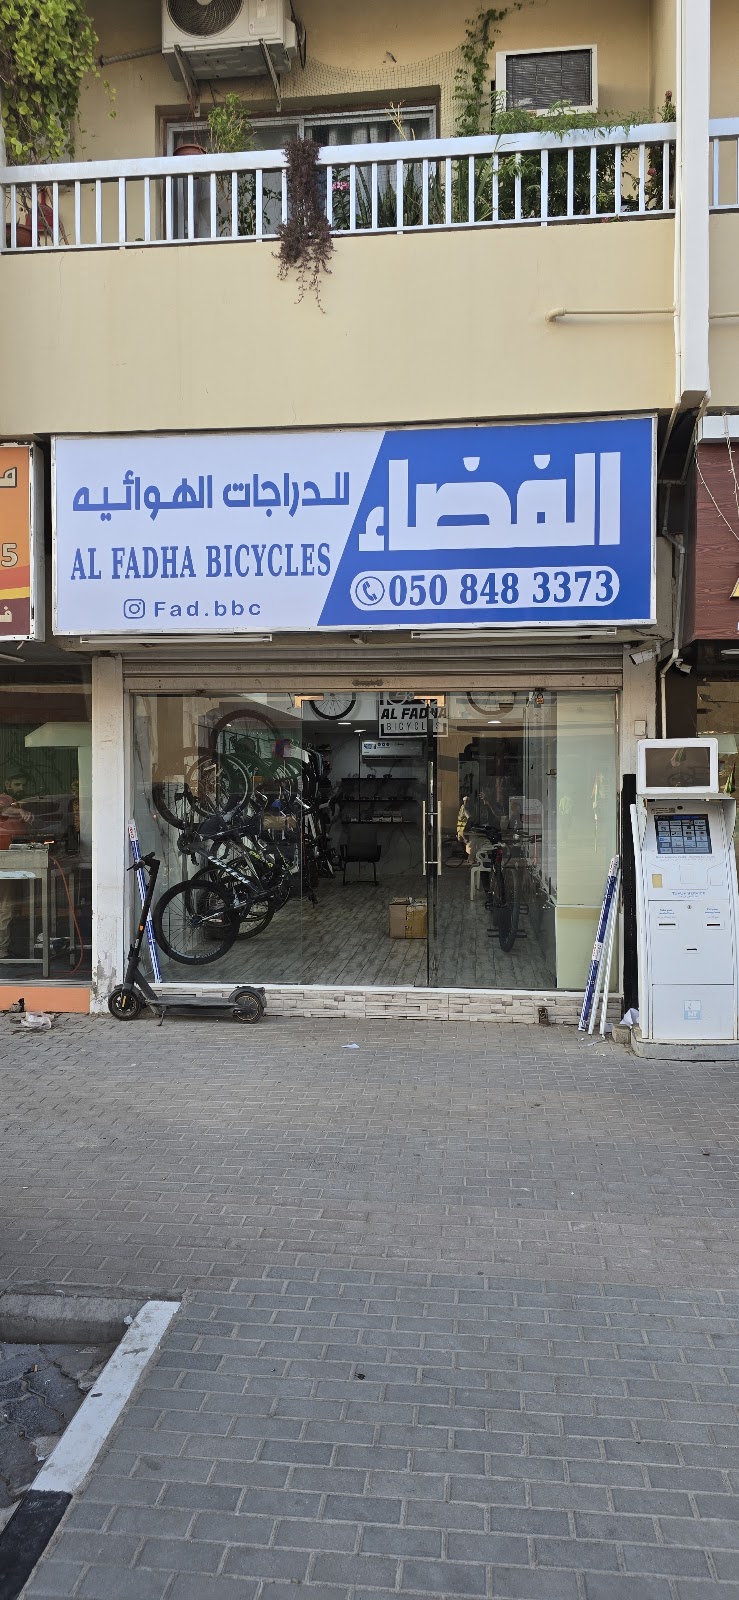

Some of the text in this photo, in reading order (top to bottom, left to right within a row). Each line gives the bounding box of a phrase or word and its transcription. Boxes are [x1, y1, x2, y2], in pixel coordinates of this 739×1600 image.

[73, 470, 349, 521] للدراجات الهوائيه
[359, 452, 621, 551] الفضاء
[71, 543, 331, 580] AL FADHA BICYCLES
[389, 570, 613, 606] 050 848 3373
[154, 600, 261, 617] Fad.bbc
[381, 708, 397, 719] AL
[387, 722, 440, 730] BICYCLS
